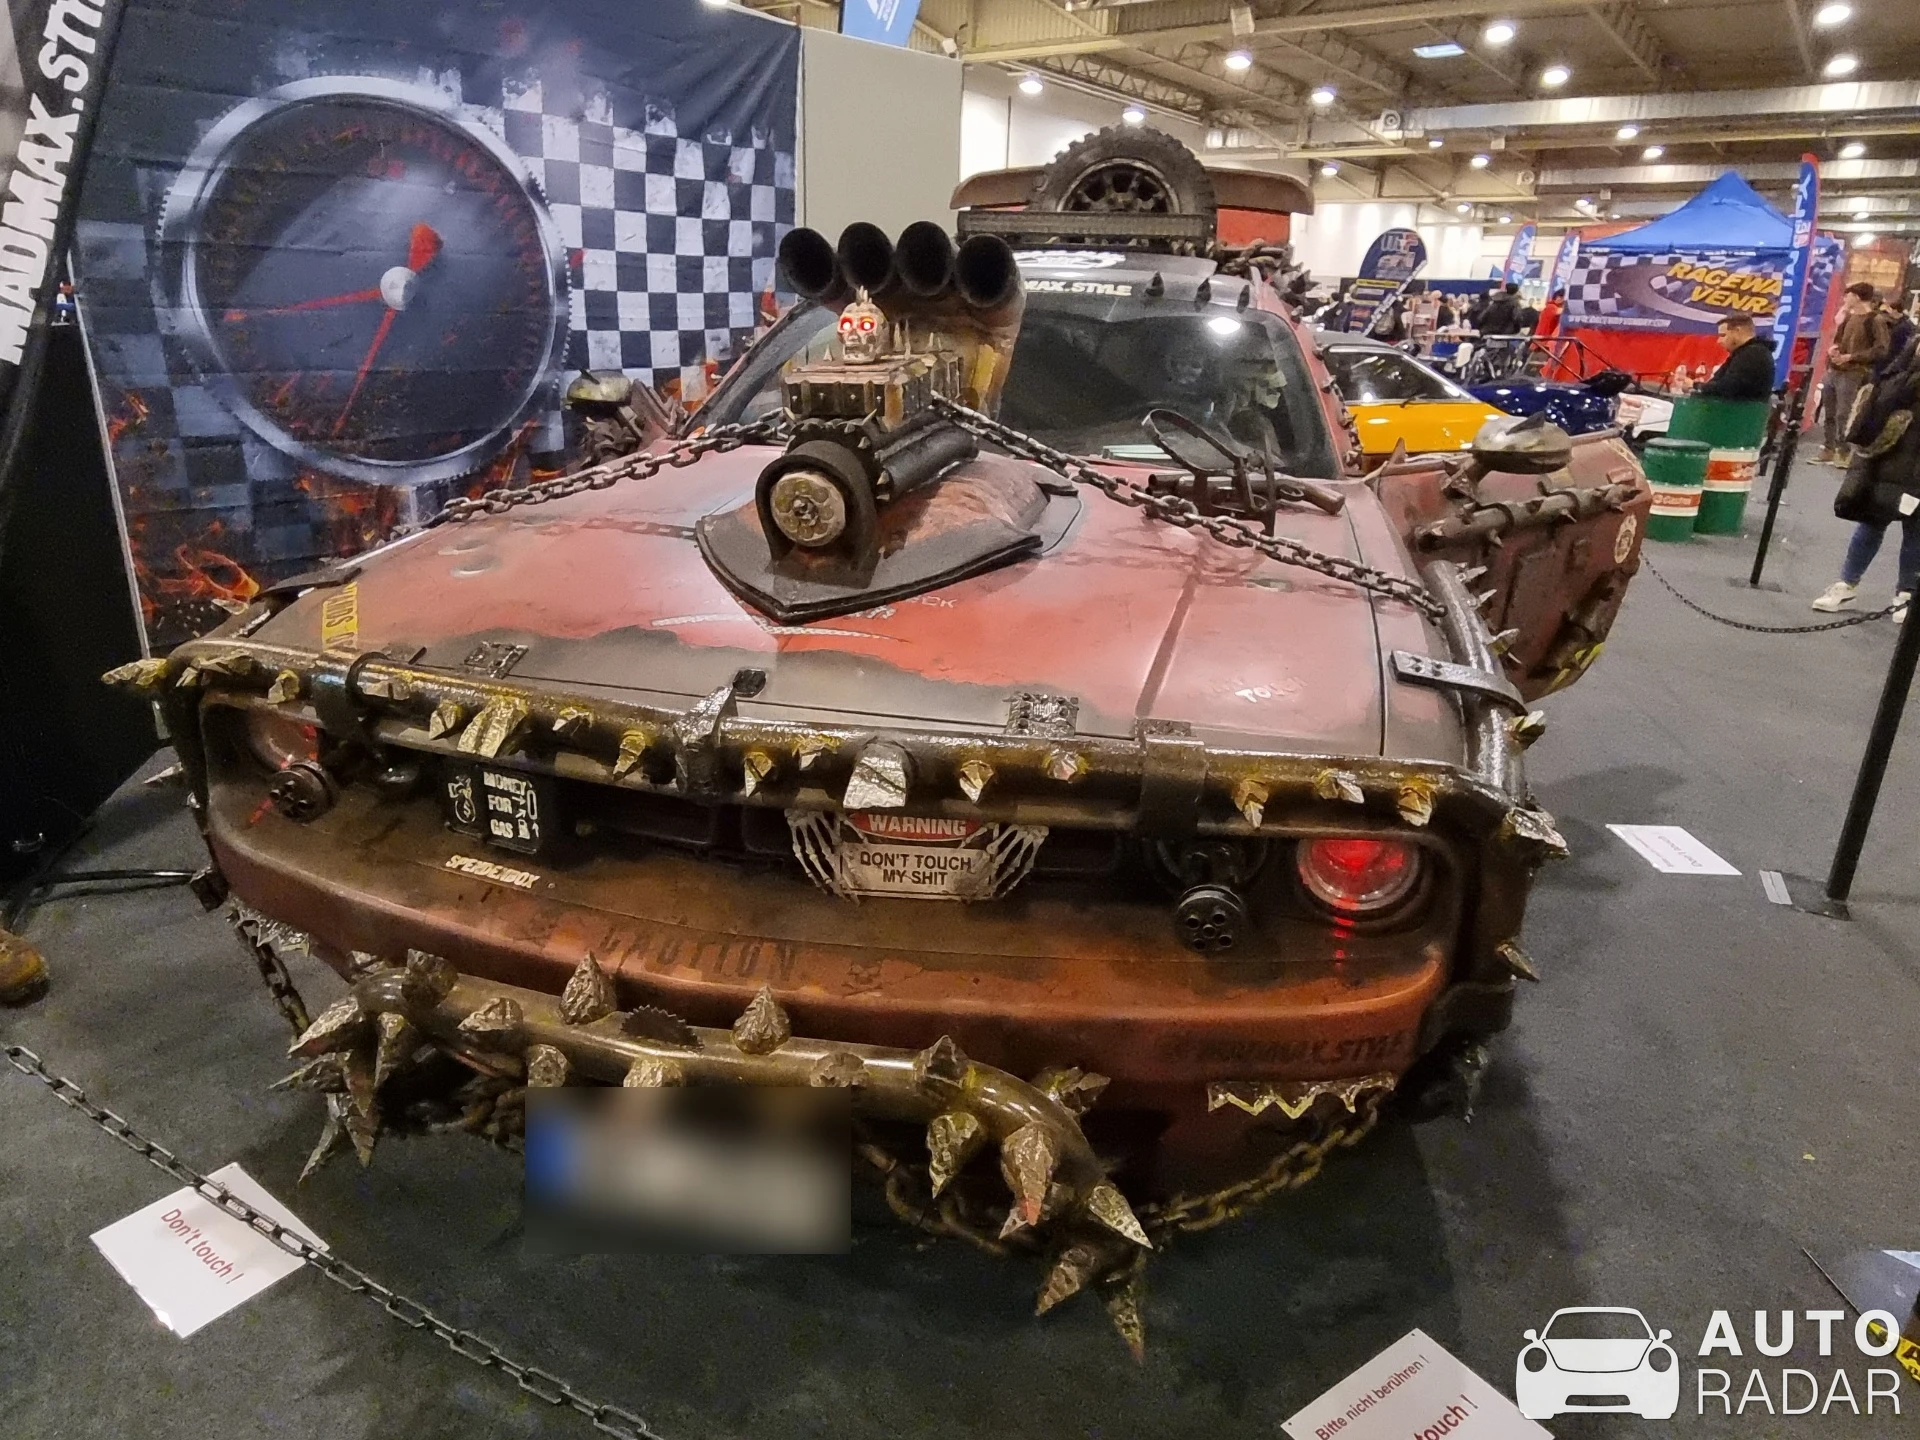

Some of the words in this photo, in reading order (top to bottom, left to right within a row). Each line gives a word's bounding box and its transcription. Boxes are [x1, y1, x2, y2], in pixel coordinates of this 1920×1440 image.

[1667, 262, 1783, 296] RACEWA
[483, 771, 527, 796] MONEY
[487, 794, 513, 815] FOR
[490, 818, 514, 839] GAS
[868, 814, 967, 836] WARNING
[860, 851, 909, 868] DON'T
[915, 854, 973, 872] TOUCH
[883, 869, 905, 883] MY
[911, 870, 948, 886] SHIT
[161, 1208, 202, 1244] Don't
[192, 1240, 234, 1278] touch
[1315, 1417, 1348, 1440] Bitte
[1346, 1394, 1378, 1420] nicht
[1371, 1361, 1424, 1399] berühren
